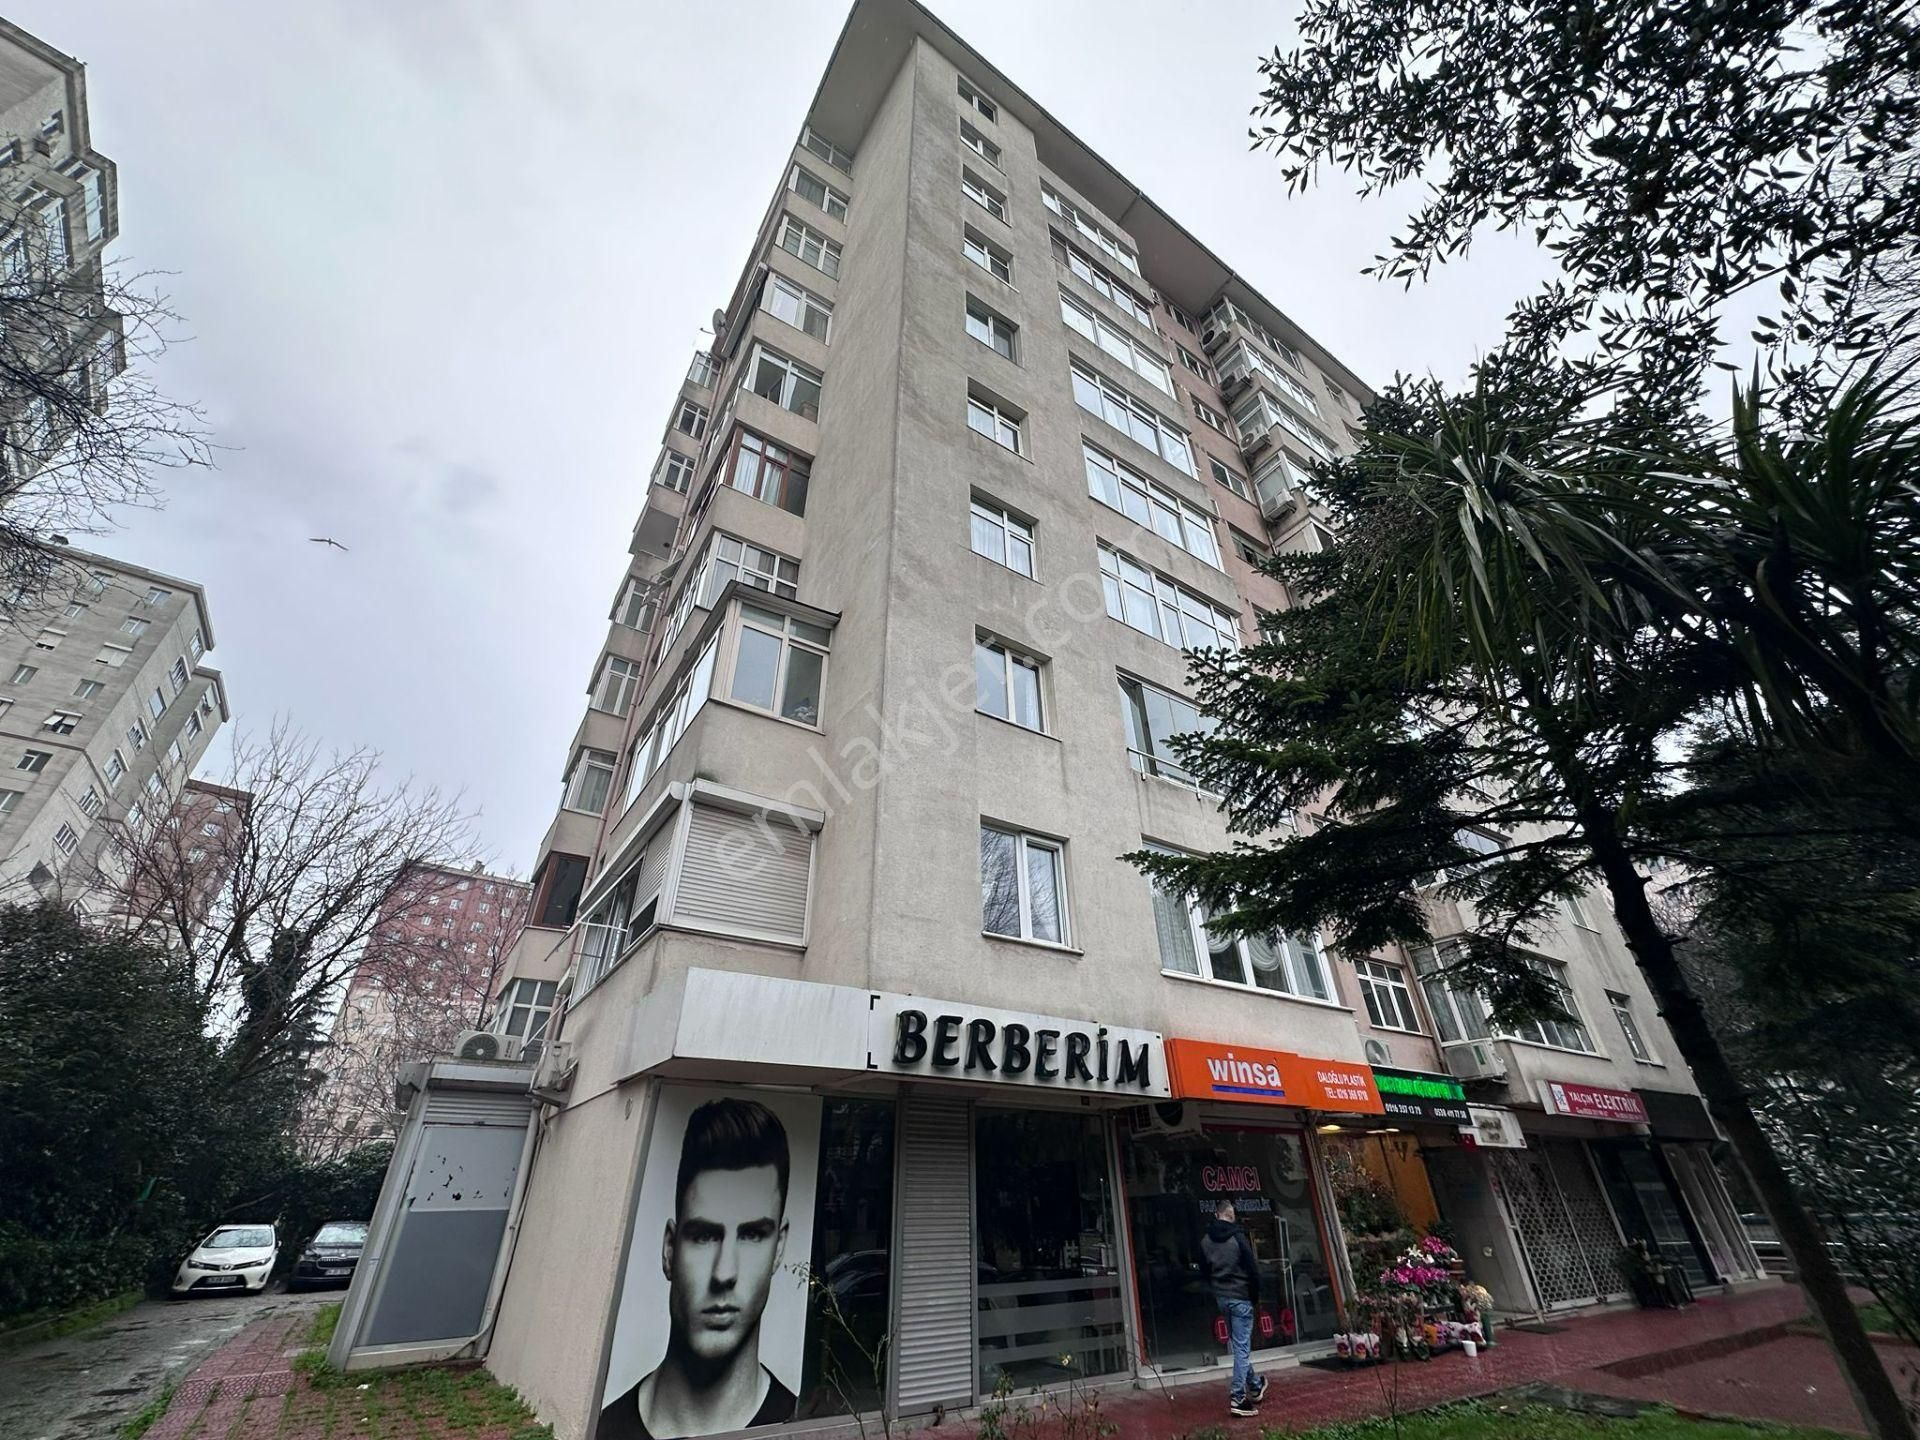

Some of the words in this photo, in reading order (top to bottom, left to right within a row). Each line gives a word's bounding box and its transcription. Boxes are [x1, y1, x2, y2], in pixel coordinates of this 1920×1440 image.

[892, 1008, 1151, 1088] BERBERİM
[1207, 1053, 1282, 1087] winsa
[1342, 1073, 1367, 1087] PLASTİK
[1568, 1091, 1594, 1105] YALÇIN
[1593, 1093, 1641, 1113] ELEKTRİK
[1202, 1166, 1261, 1191] CAMCI
